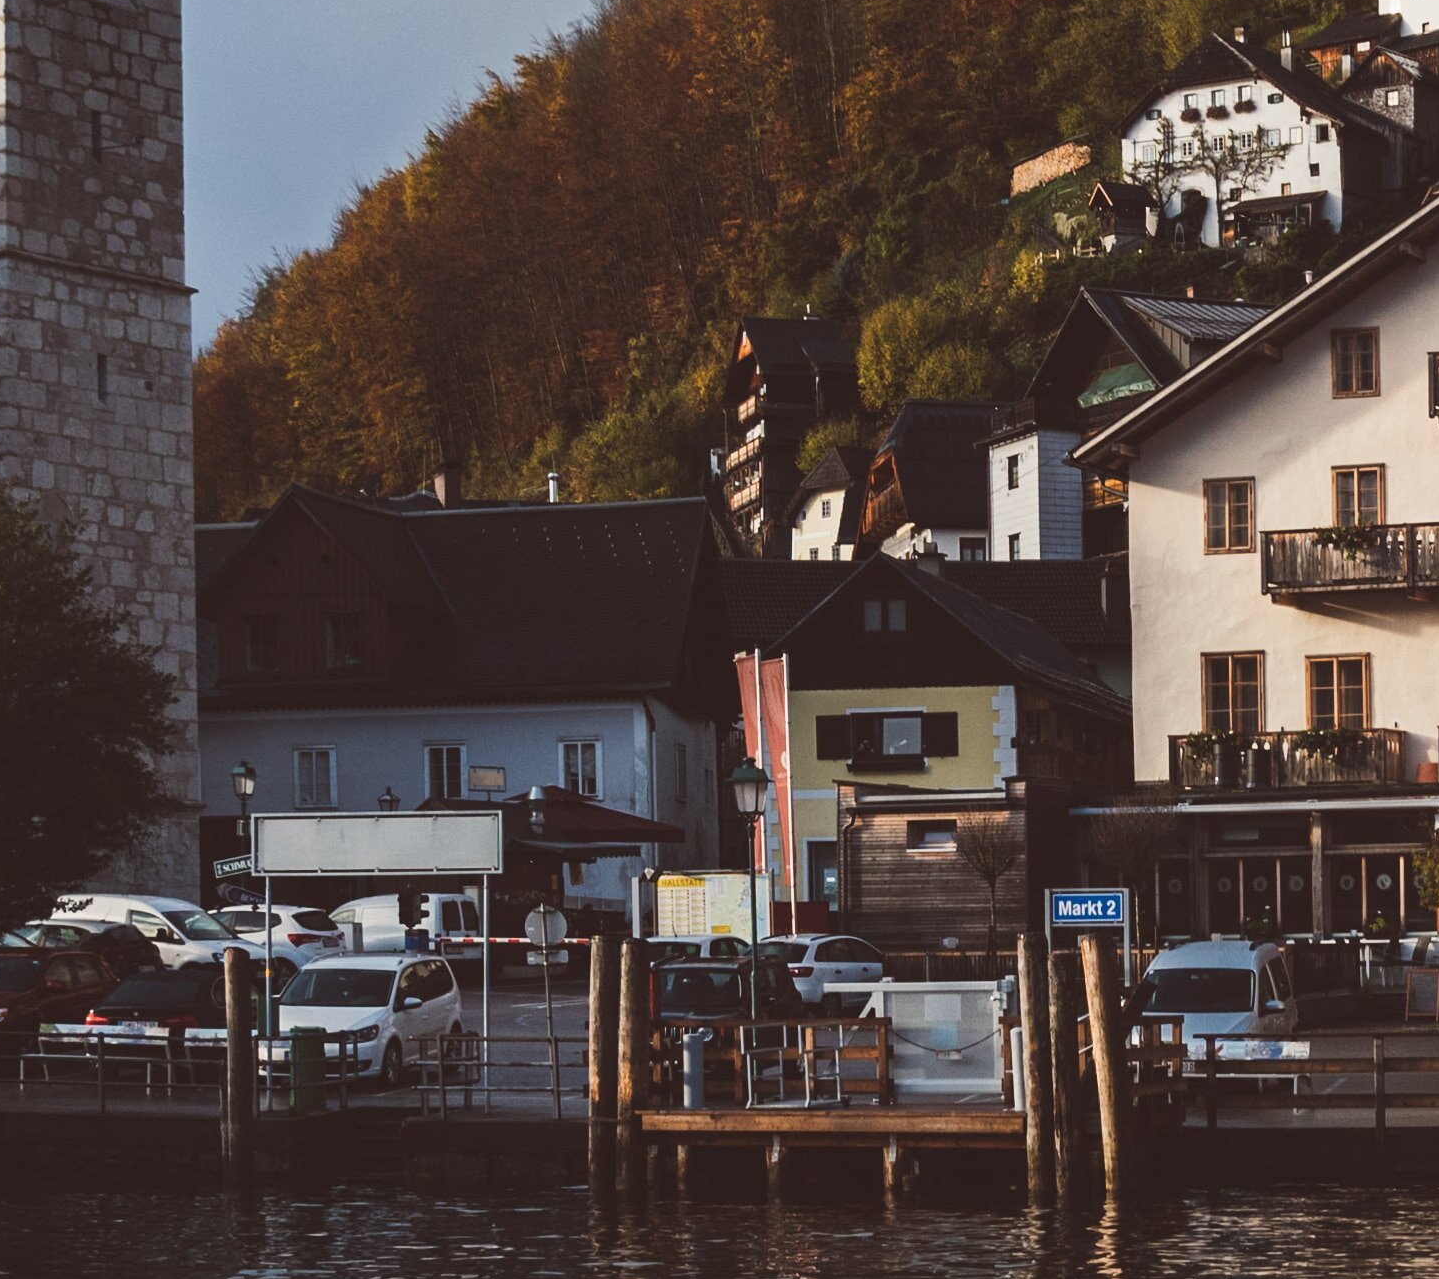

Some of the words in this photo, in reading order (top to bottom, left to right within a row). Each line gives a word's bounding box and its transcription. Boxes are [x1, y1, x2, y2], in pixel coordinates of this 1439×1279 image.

[661, 879, 703, 888] HALLSTATT
[1058, 900, 1103, 916] Markt
[1106, 899, 1117, 916] 2
